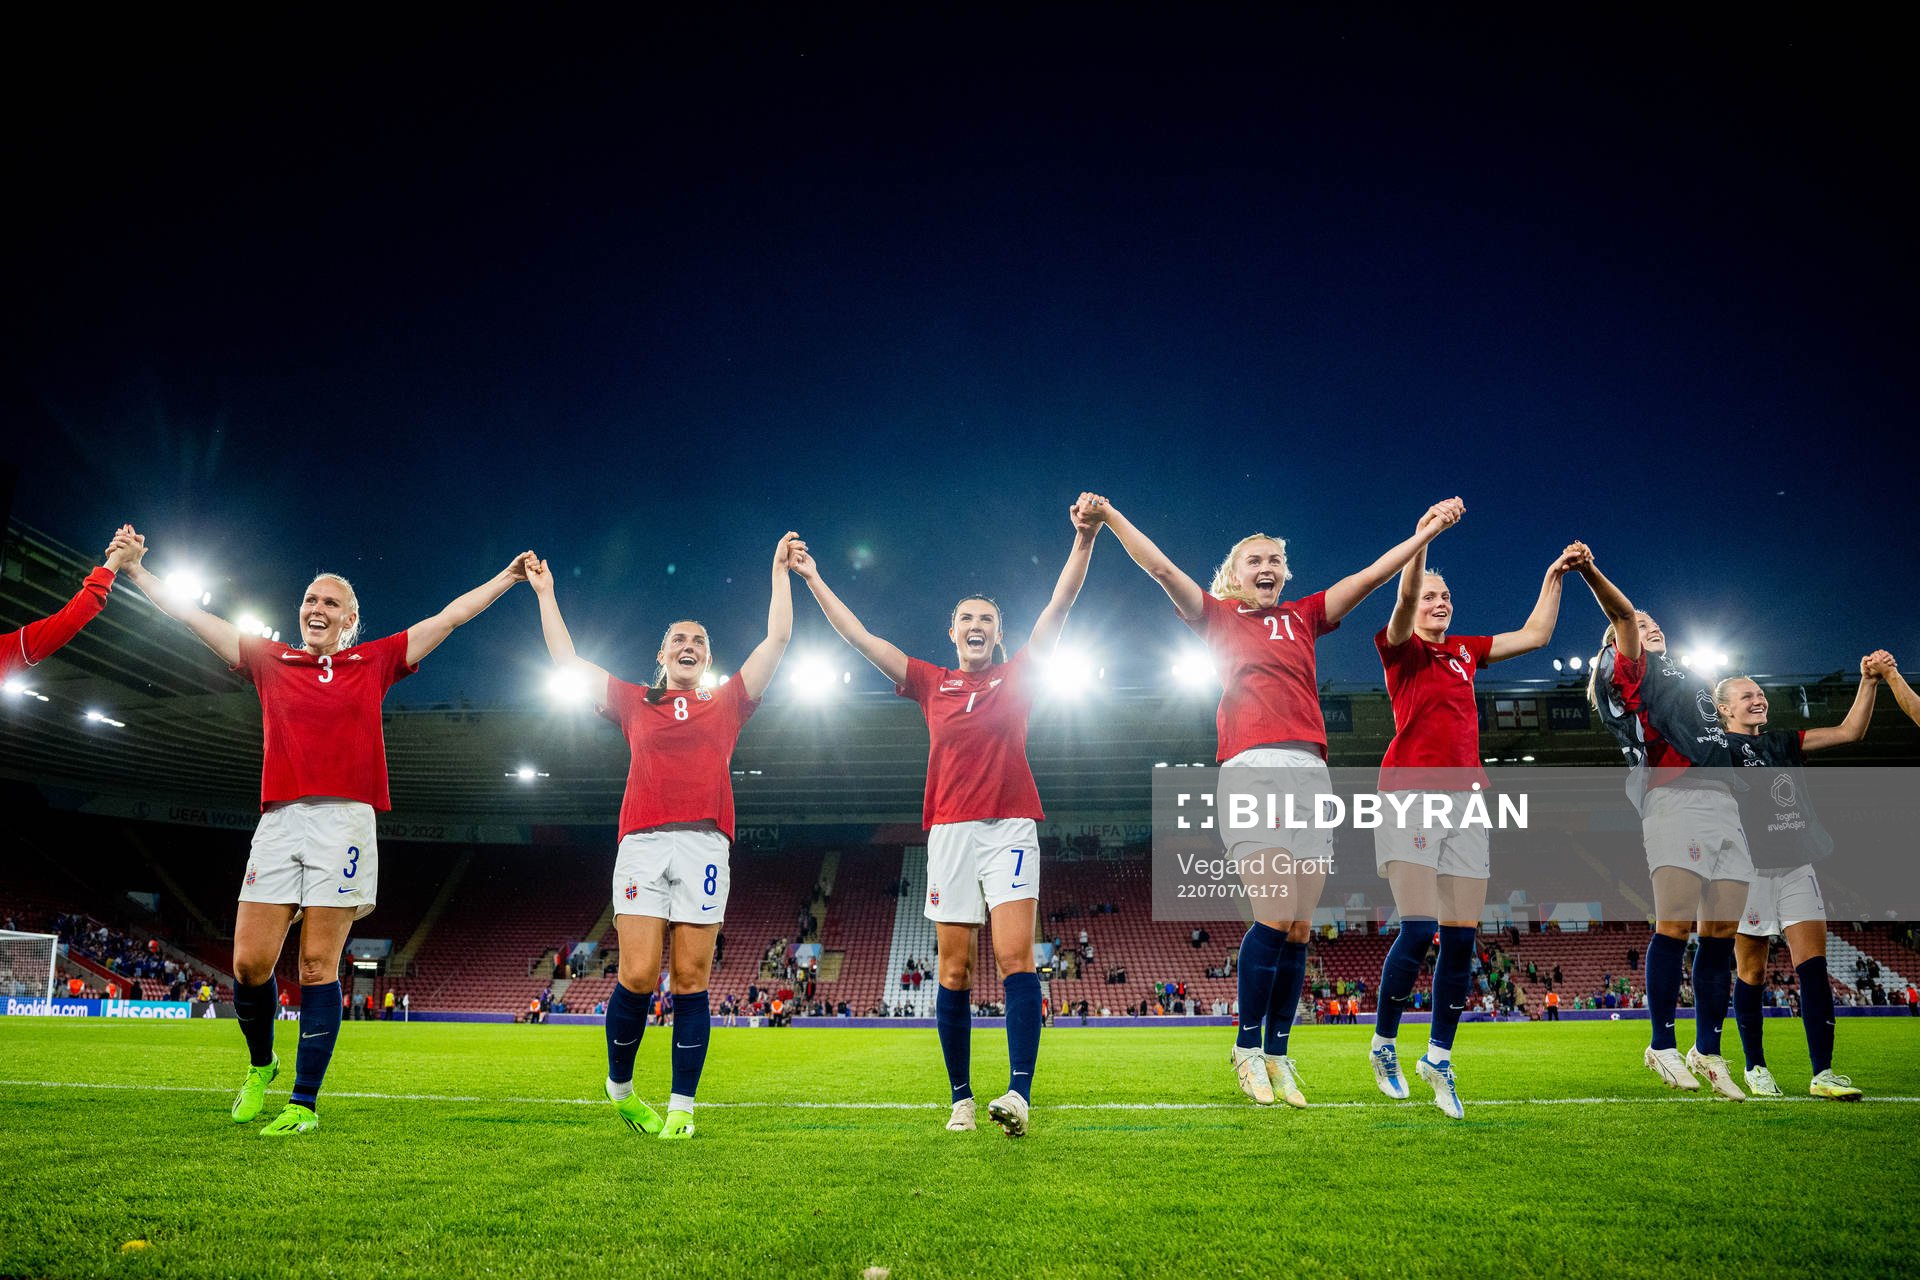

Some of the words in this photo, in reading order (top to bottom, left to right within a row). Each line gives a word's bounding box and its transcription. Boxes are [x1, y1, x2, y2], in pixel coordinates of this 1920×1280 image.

[1263, 614, 1295, 641] 21
[317, 655, 335, 683] 3
[1449, 657, 1468, 681] 9
[673, 696, 689, 721] 8
[1551, 707, 1582, 720] FIFA
[168, 807, 207, 825] UEFA
[410, 826, 443, 839] 2022
[343, 846, 360, 879] 3
[1010, 849, 1025, 877] 7
[703, 863, 719, 897] 8
[7, 998, 88, 1017] Bookig.com
[106, 999, 187, 1019] Hisense
